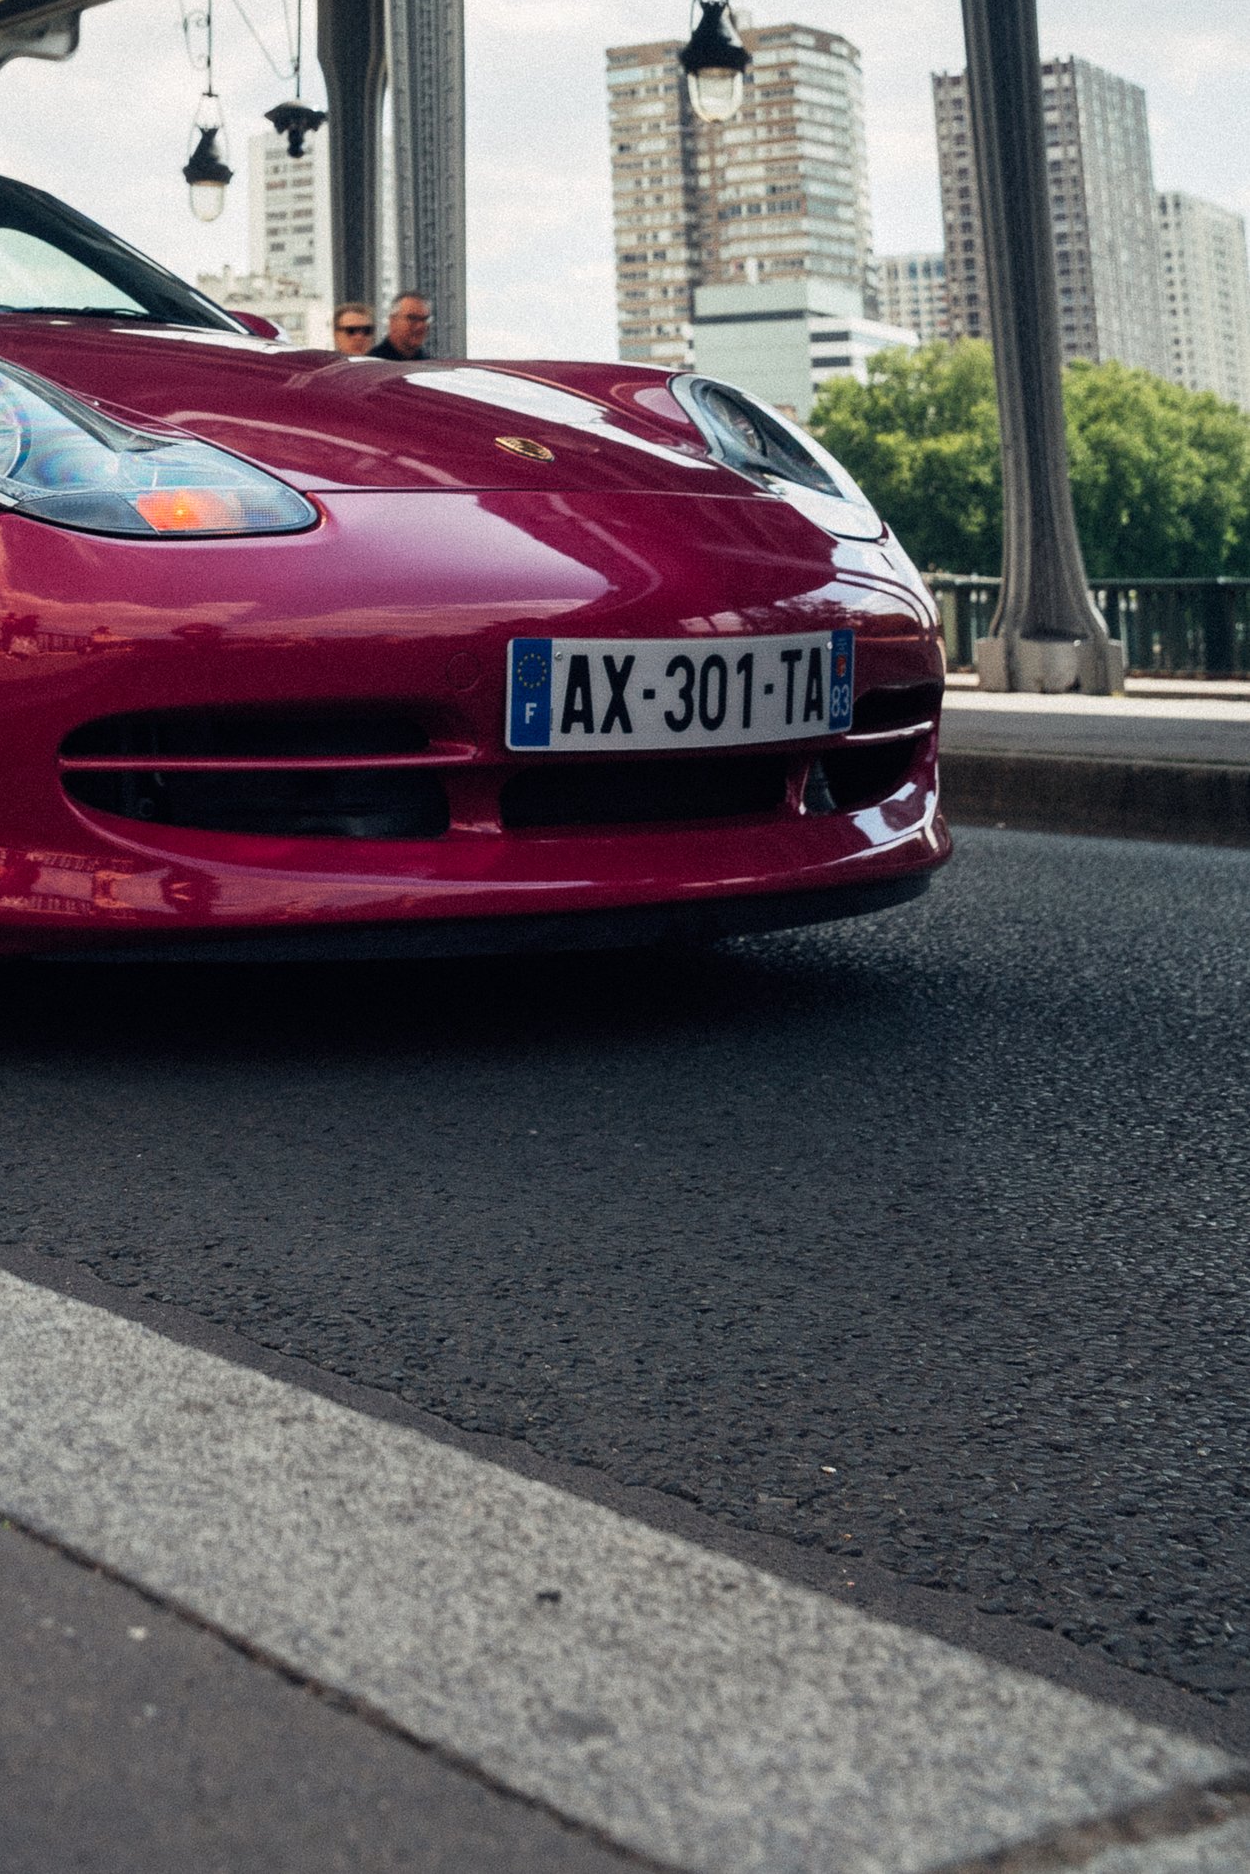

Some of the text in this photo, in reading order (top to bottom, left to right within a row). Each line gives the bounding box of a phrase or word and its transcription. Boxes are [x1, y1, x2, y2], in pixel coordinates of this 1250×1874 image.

[561, 647, 824, 734] AX-301-TA
[831, 683, 850, 718] 83
[524, 702, 537, 724] F
